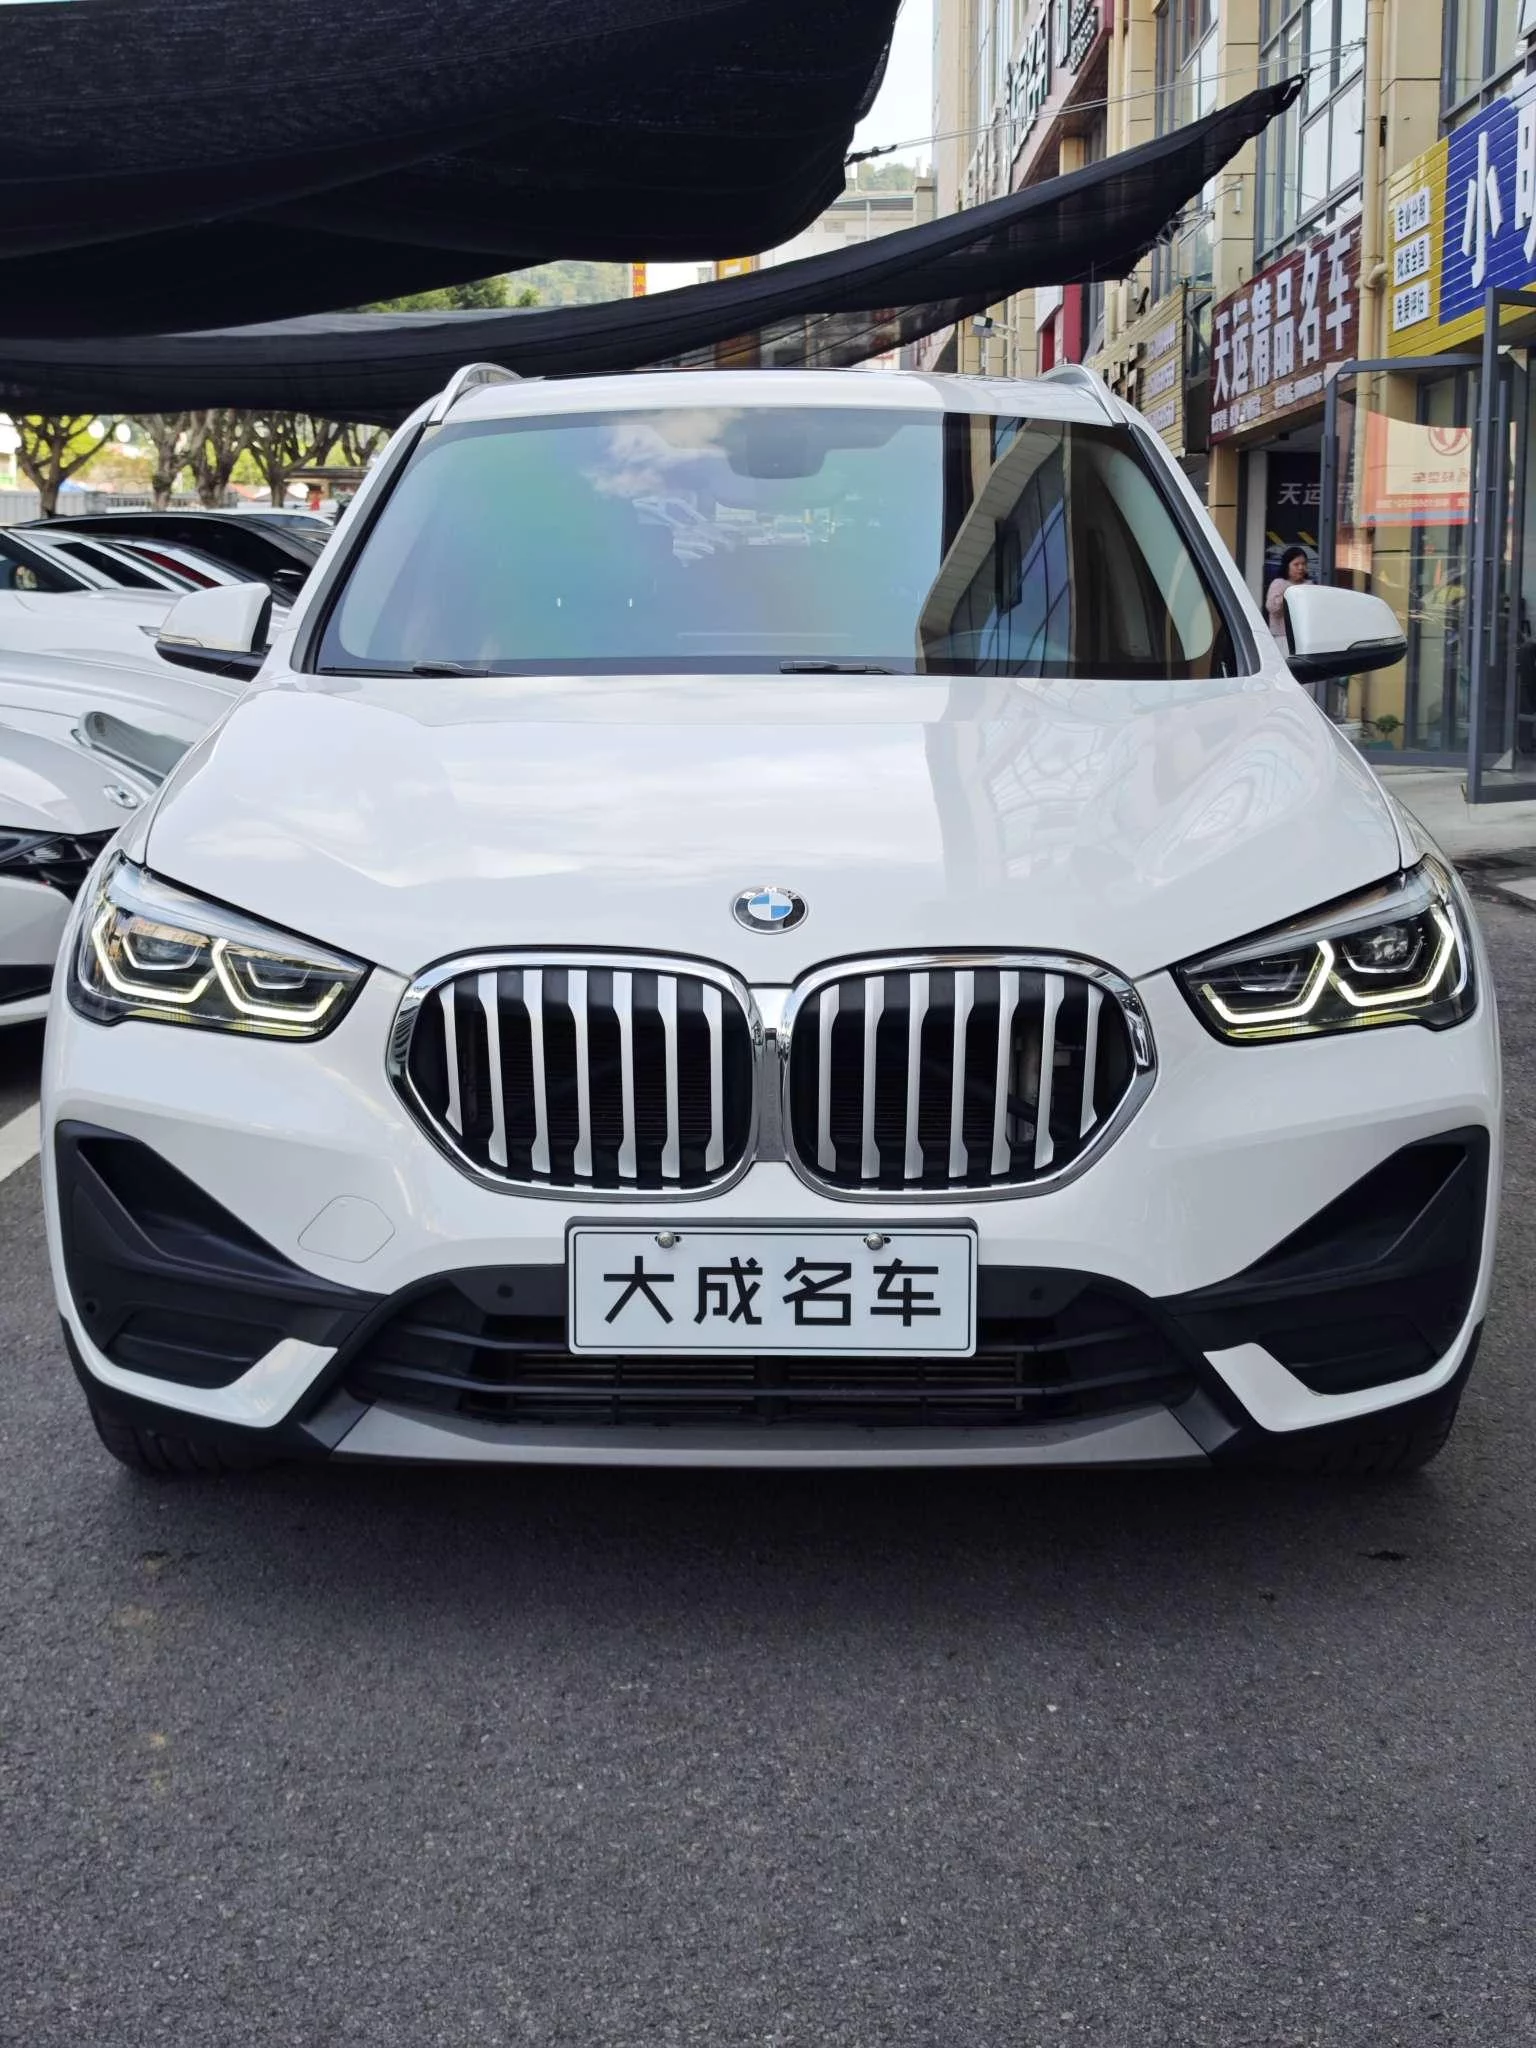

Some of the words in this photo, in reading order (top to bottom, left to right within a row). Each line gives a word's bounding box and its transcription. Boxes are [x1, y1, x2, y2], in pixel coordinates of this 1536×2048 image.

[1213, 229, 1353, 407] 天运精品名车
[603, 1255, 941, 1326] 大成名车
